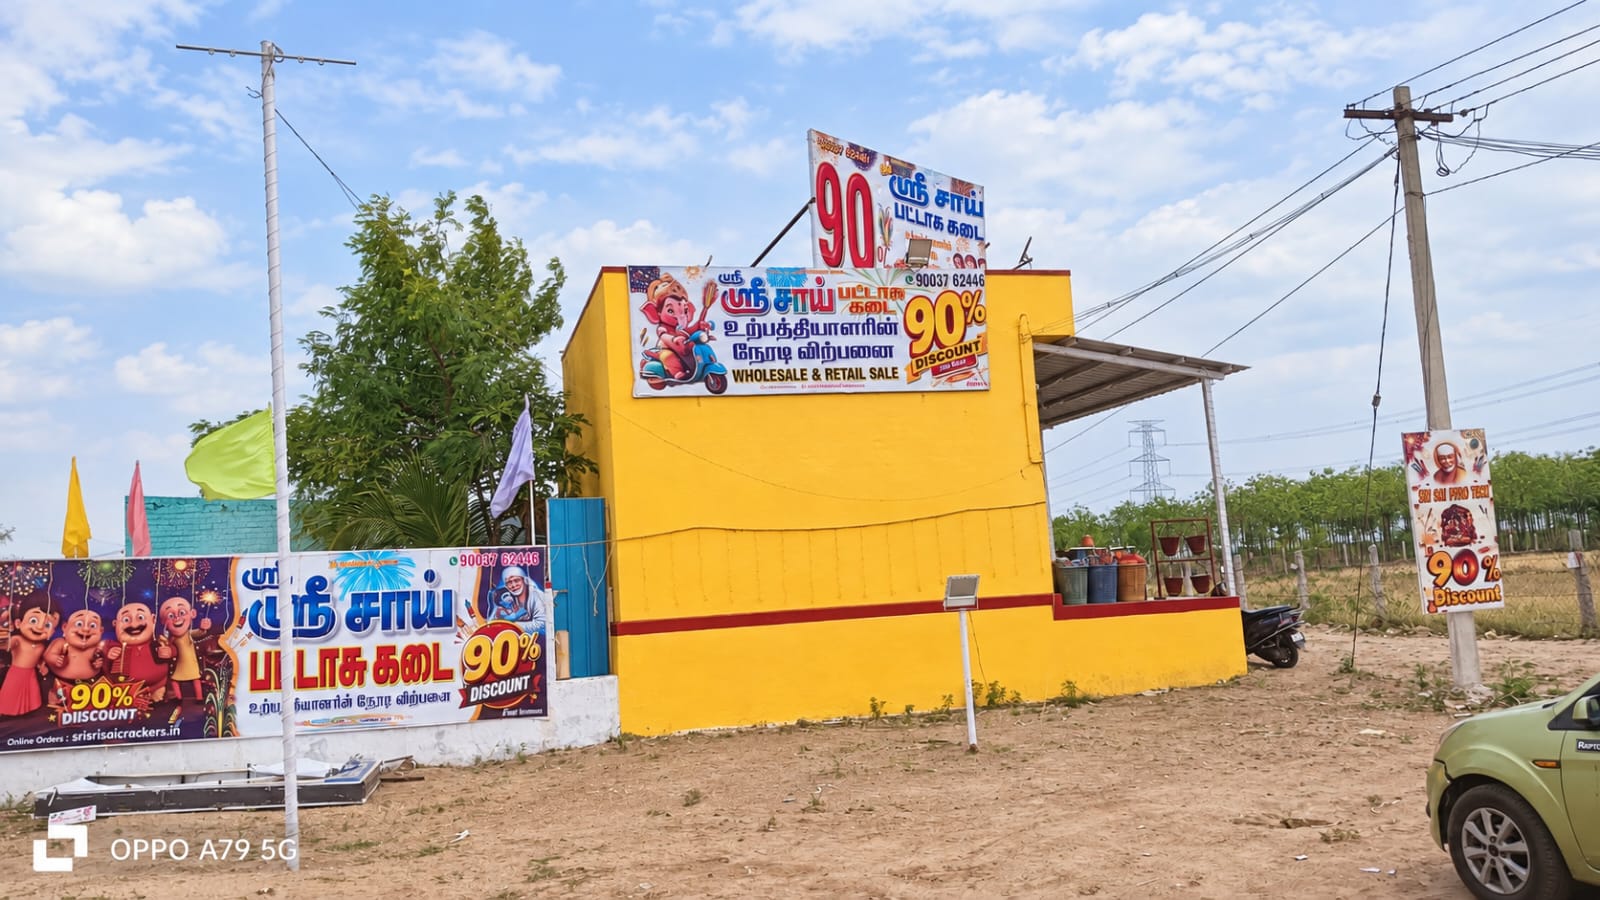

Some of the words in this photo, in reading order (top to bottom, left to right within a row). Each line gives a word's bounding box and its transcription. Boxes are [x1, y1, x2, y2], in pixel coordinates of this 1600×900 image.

[935, 189, 984, 218] சாய்
[947, 220, 985, 241] கடை
[916, 274, 948, 287] 90037
[953, 273, 985, 287] 62446
[774, 278, 834, 314] சாய்
[849, 301, 897, 314] கடை
[724, 317, 898, 341] உற்பத்தியாளரின்
[904, 290, 987, 358] 90%
[733, 343, 793, 365] நேரடி
[798, 341, 894, 364] விற்பனை
[915, 340, 981, 370] DISCOUNT
[732, 368, 808, 382] WHOLESALE
[812, 368, 822, 381] &
[825, 368, 866, 381] RETAIL
[869, 367, 899, 380] SALE
[460, 553, 498, 567] 90037
[501, 552, 540, 567] 62446
[1427, 549, 1500, 588] 90%
[345, 569, 454, 634] சாய்
[1433, 584, 1502, 608] Discount
[372, 642, 455, 687] கடை
[463, 629, 541, 685] 90%
[71, 683, 133, 710] 90%
[470, 675, 530, 702] DISCOUNT
[7, 737, 34, 746] Online
[36, 735, 64, 744] Orders
[72, 726, 180, 742] srisrisaicrackers.in
